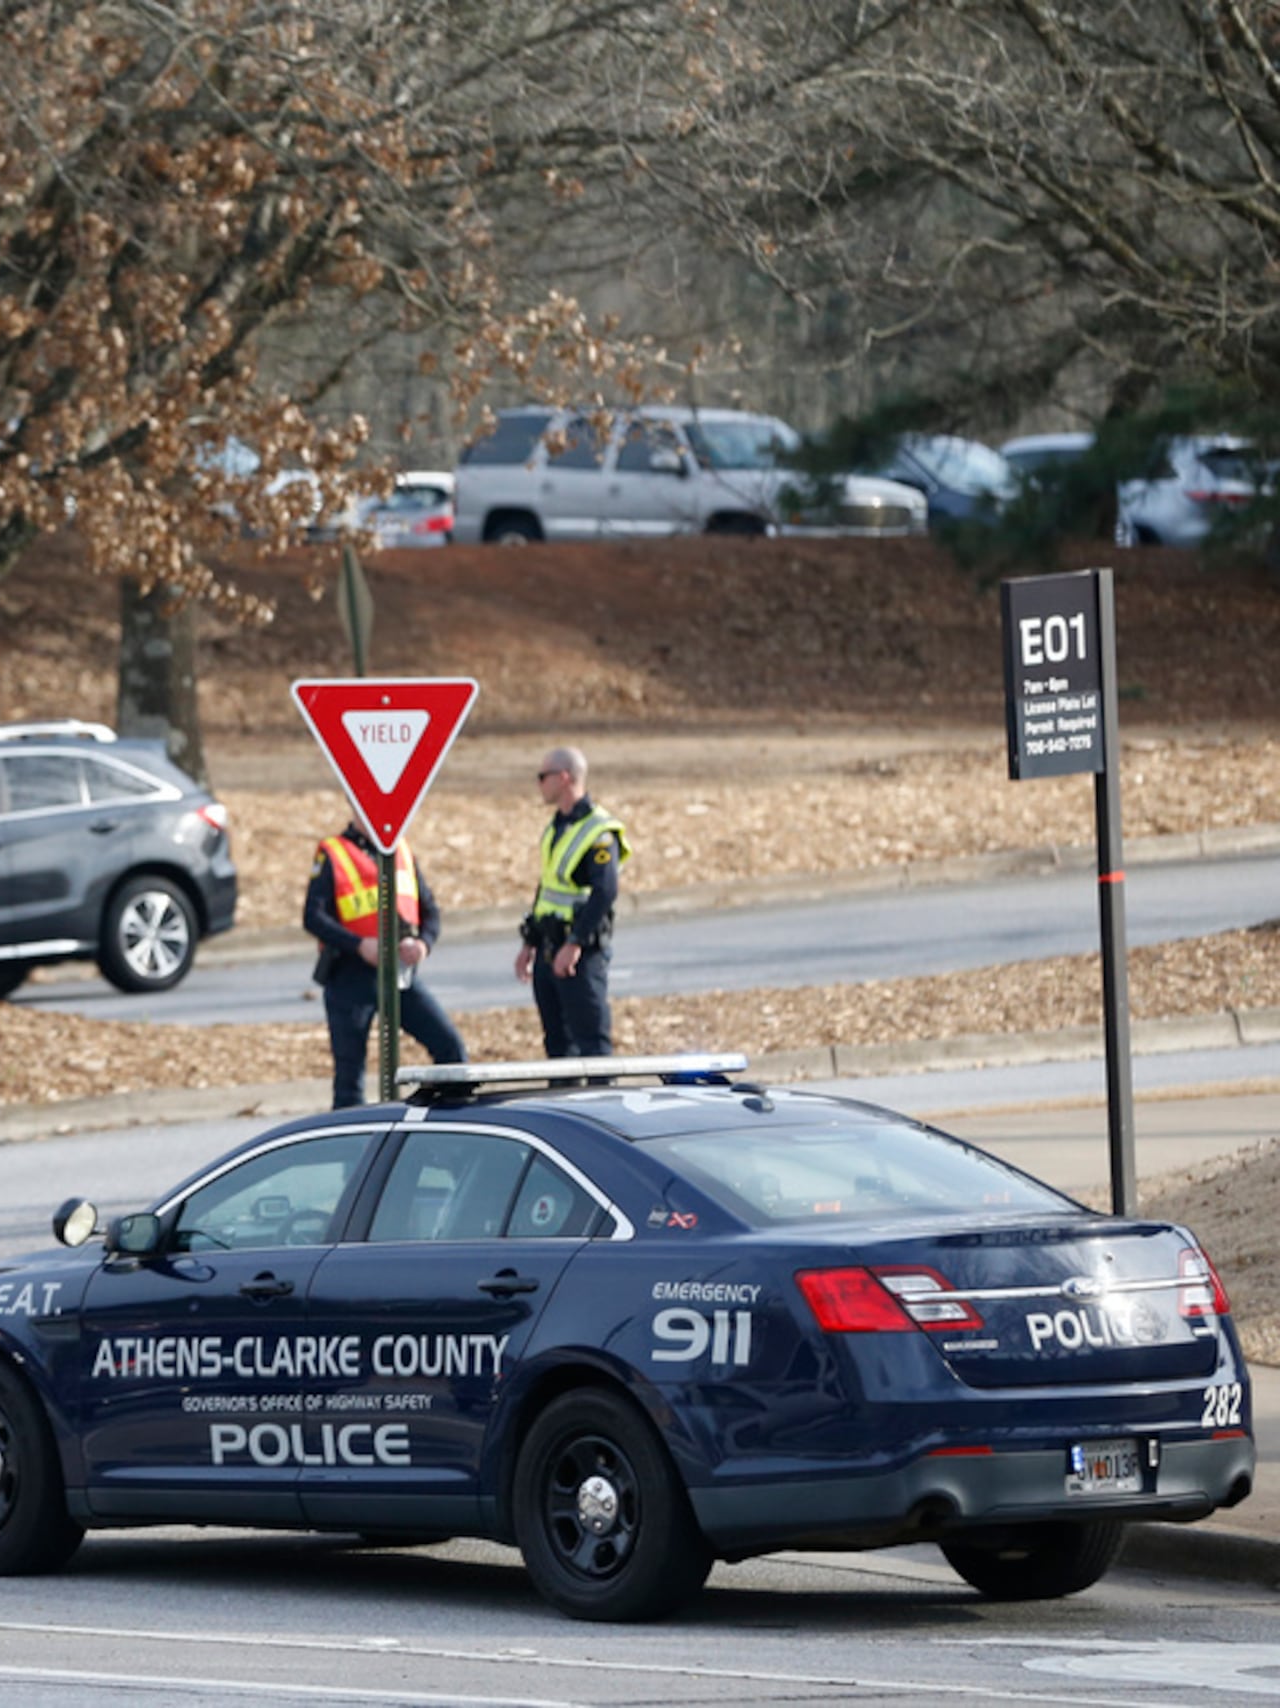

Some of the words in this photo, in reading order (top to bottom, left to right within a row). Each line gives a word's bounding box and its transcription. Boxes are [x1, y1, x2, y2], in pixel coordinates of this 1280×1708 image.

[1019, 612, 1086, 666] E01
[360, 723, 412, 744] YIELD
[652, 1281, 761, 1303] EMERGENCY
[91, 1336, 359, 1378] ATHENS-CLARKE
[372, 1334, 511, 1376] COUNTY
[651, 1306, 752, 1366] 911
[260, 1395, 303, 1412] OFFICE
[304, 1395, 323, 1411] OF
[326, 1395, 382, 1411] HIGHWAY
[384, 1394, 433, 1411] SAFETY
[1201, 1382, 1242, 1428] 282
[210, 1423, 411, 1465] POLICE
